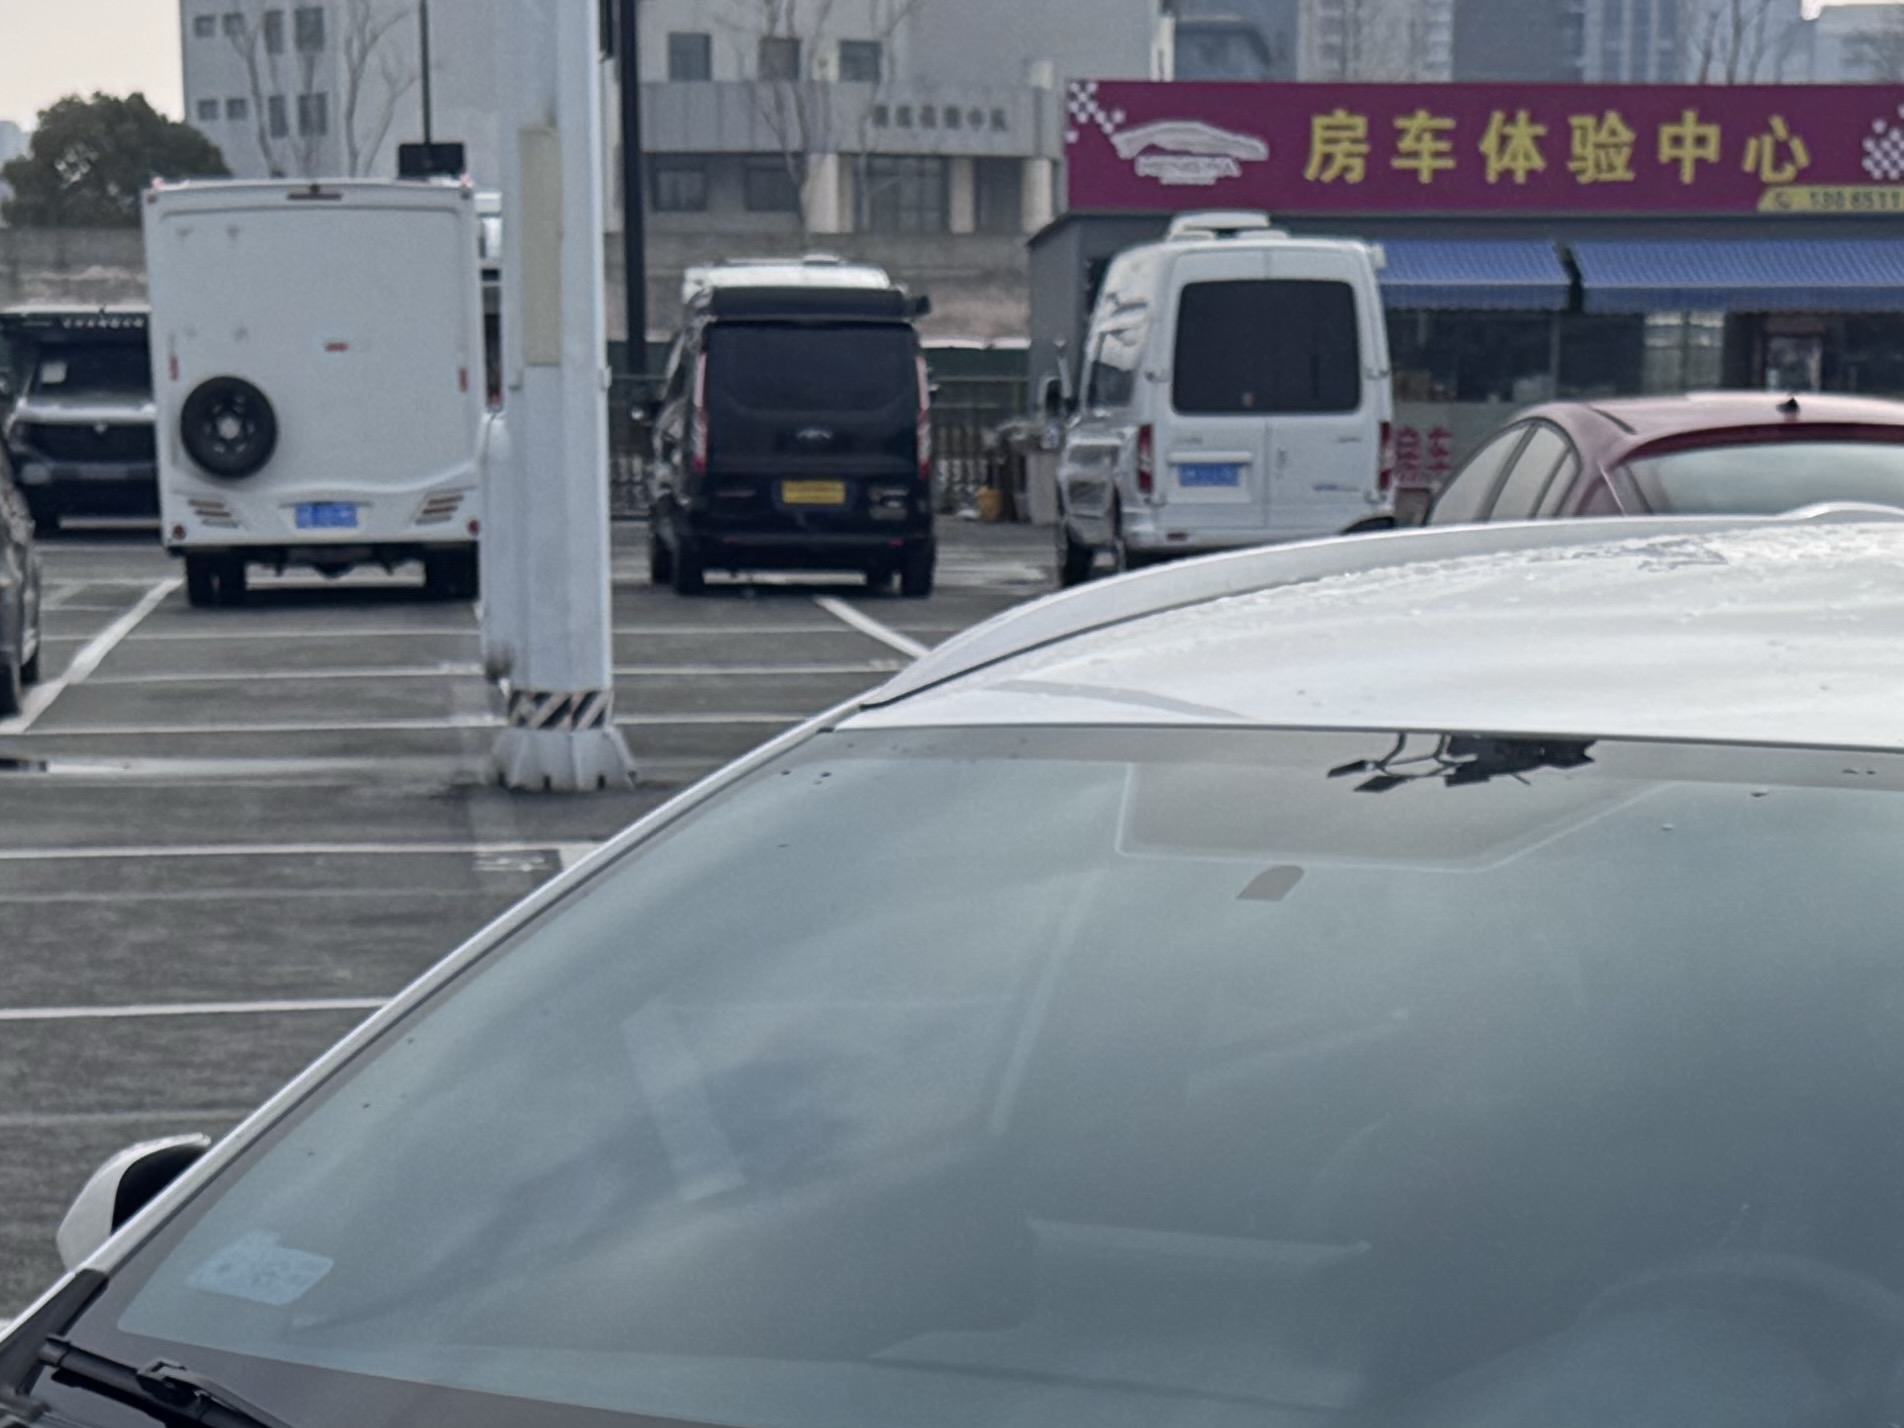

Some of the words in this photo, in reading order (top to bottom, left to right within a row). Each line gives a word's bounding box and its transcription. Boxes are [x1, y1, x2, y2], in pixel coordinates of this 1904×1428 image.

[1303, 107, 1811, 185] 房车体验中心
